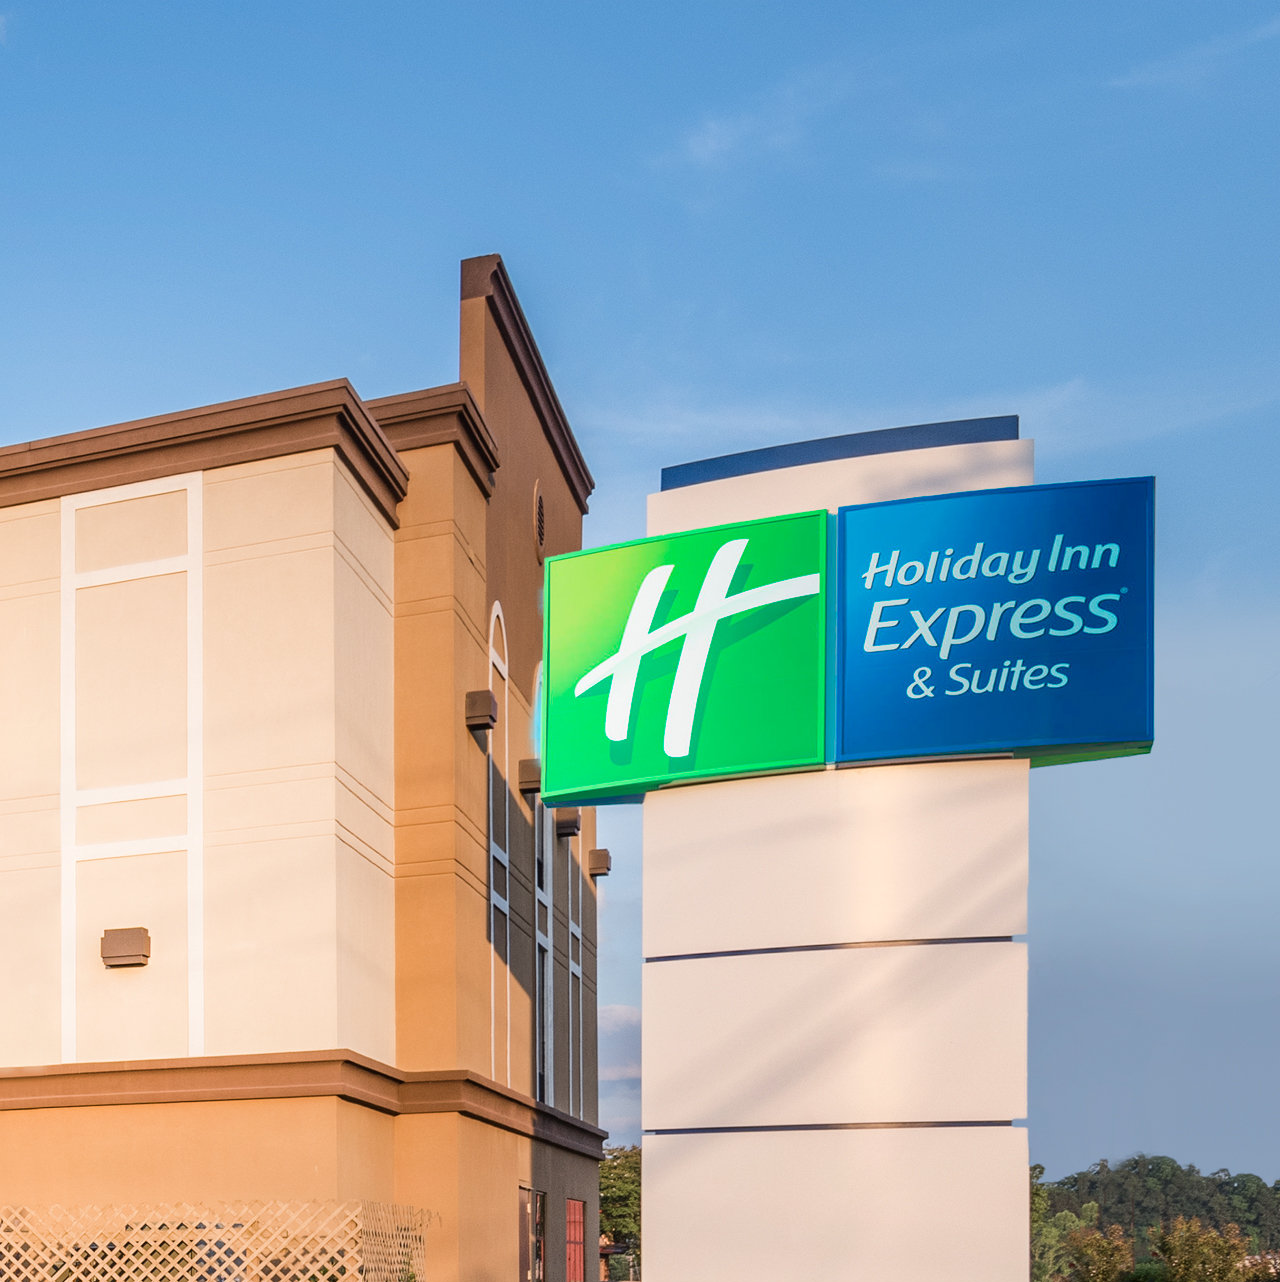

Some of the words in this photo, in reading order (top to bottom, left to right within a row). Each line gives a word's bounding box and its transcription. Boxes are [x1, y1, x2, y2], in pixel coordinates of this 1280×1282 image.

[861, 541, 1040, 590] Holiday
[1048, 534, 1120, 573] Inn
[863, 592, 1121, 660] Express
[906, 666, 936, 699] &
[944, 660, 1071, 697] Suites
